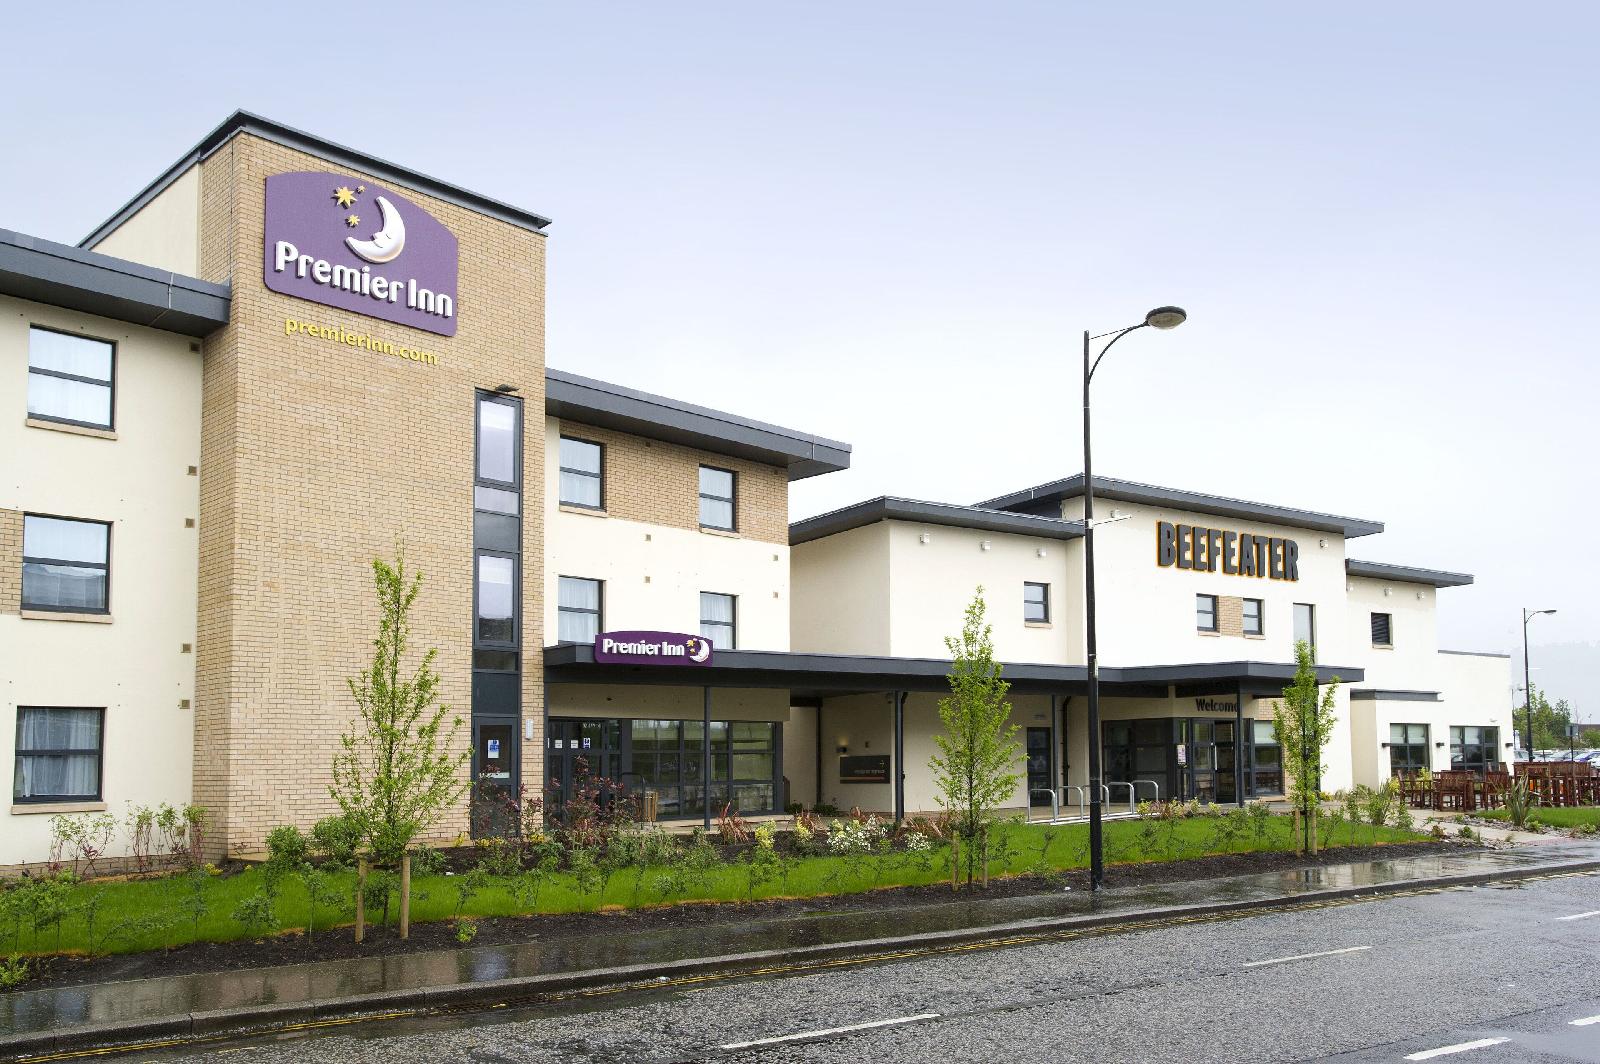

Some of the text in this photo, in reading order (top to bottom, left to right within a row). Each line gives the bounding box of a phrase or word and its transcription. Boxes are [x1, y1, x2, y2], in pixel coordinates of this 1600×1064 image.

[275, 240, 453, 317] Premier Inn
[285, 318, 438, 365] premierinn.com
[1156, 520, 1299, 582] BEEFEATER
[602, 638, 685, 656] Premier Inn
